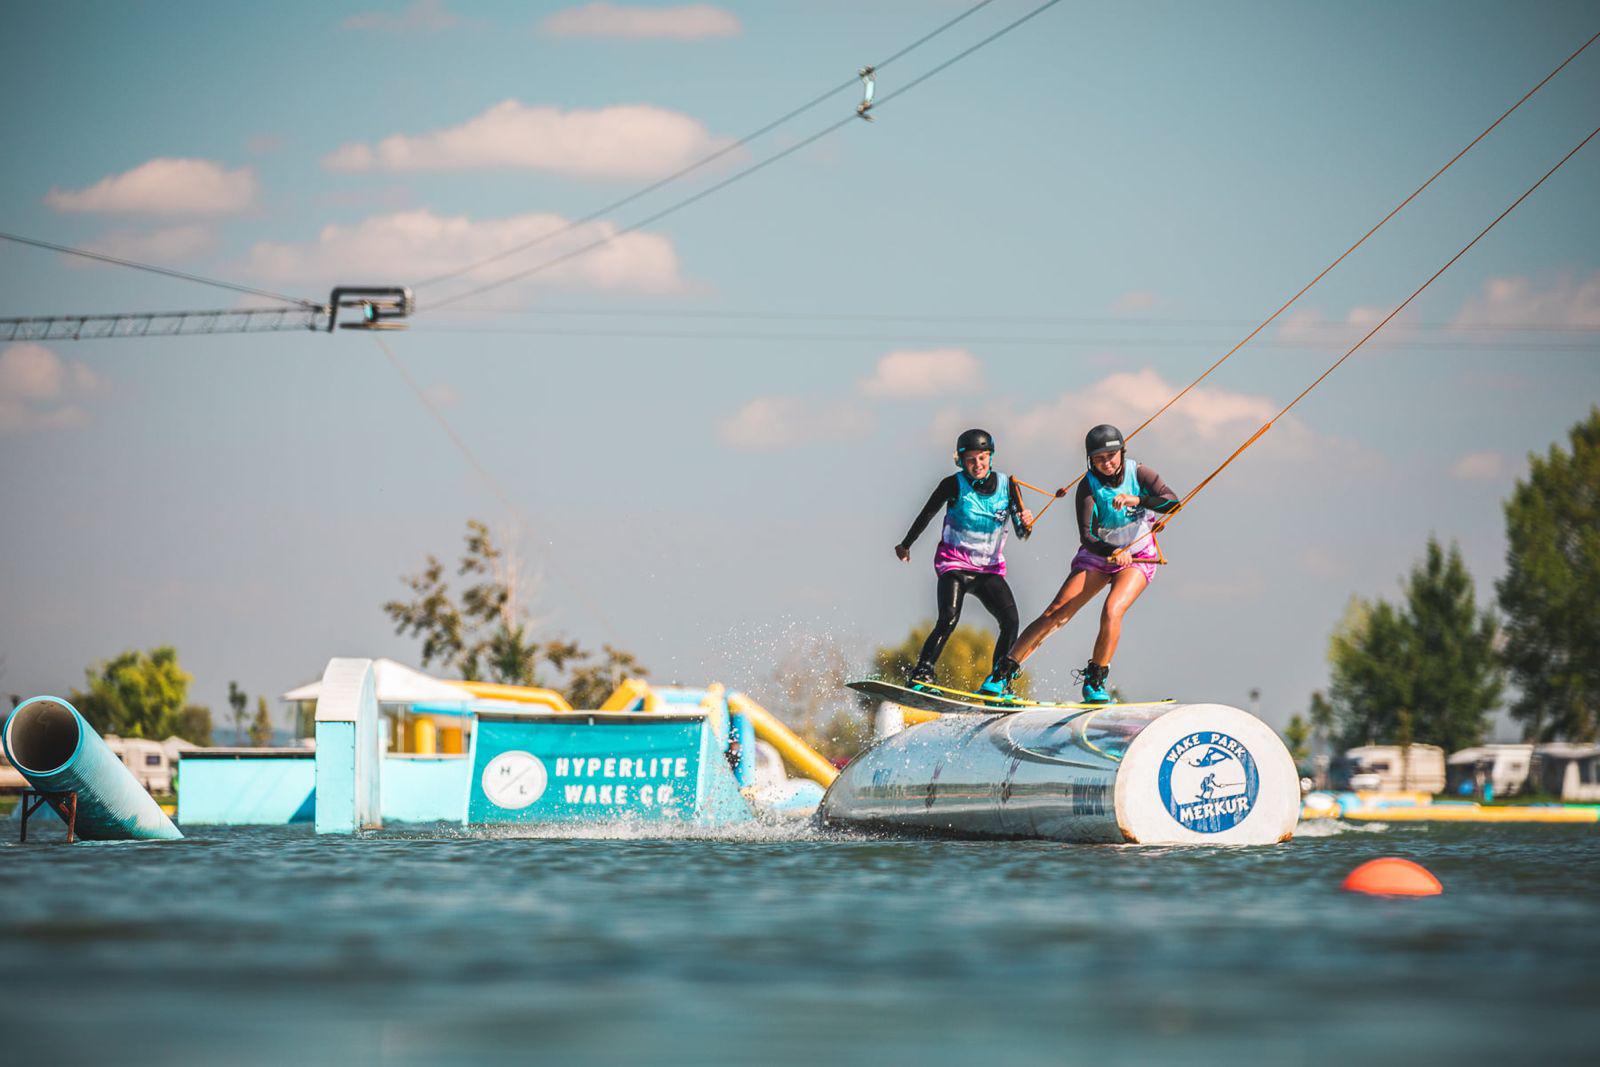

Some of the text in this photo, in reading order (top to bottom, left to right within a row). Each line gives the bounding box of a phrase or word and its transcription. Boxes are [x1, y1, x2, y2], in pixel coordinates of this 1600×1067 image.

[1166, 734, 1245, 763] WAKE PARK
[501, 766, 510, 775] H
[555, 757, 687, 777] HYPERLITE
[564, 784, 628, 804] WAKE
[1180, 797, 1250, 822] MERKUR
